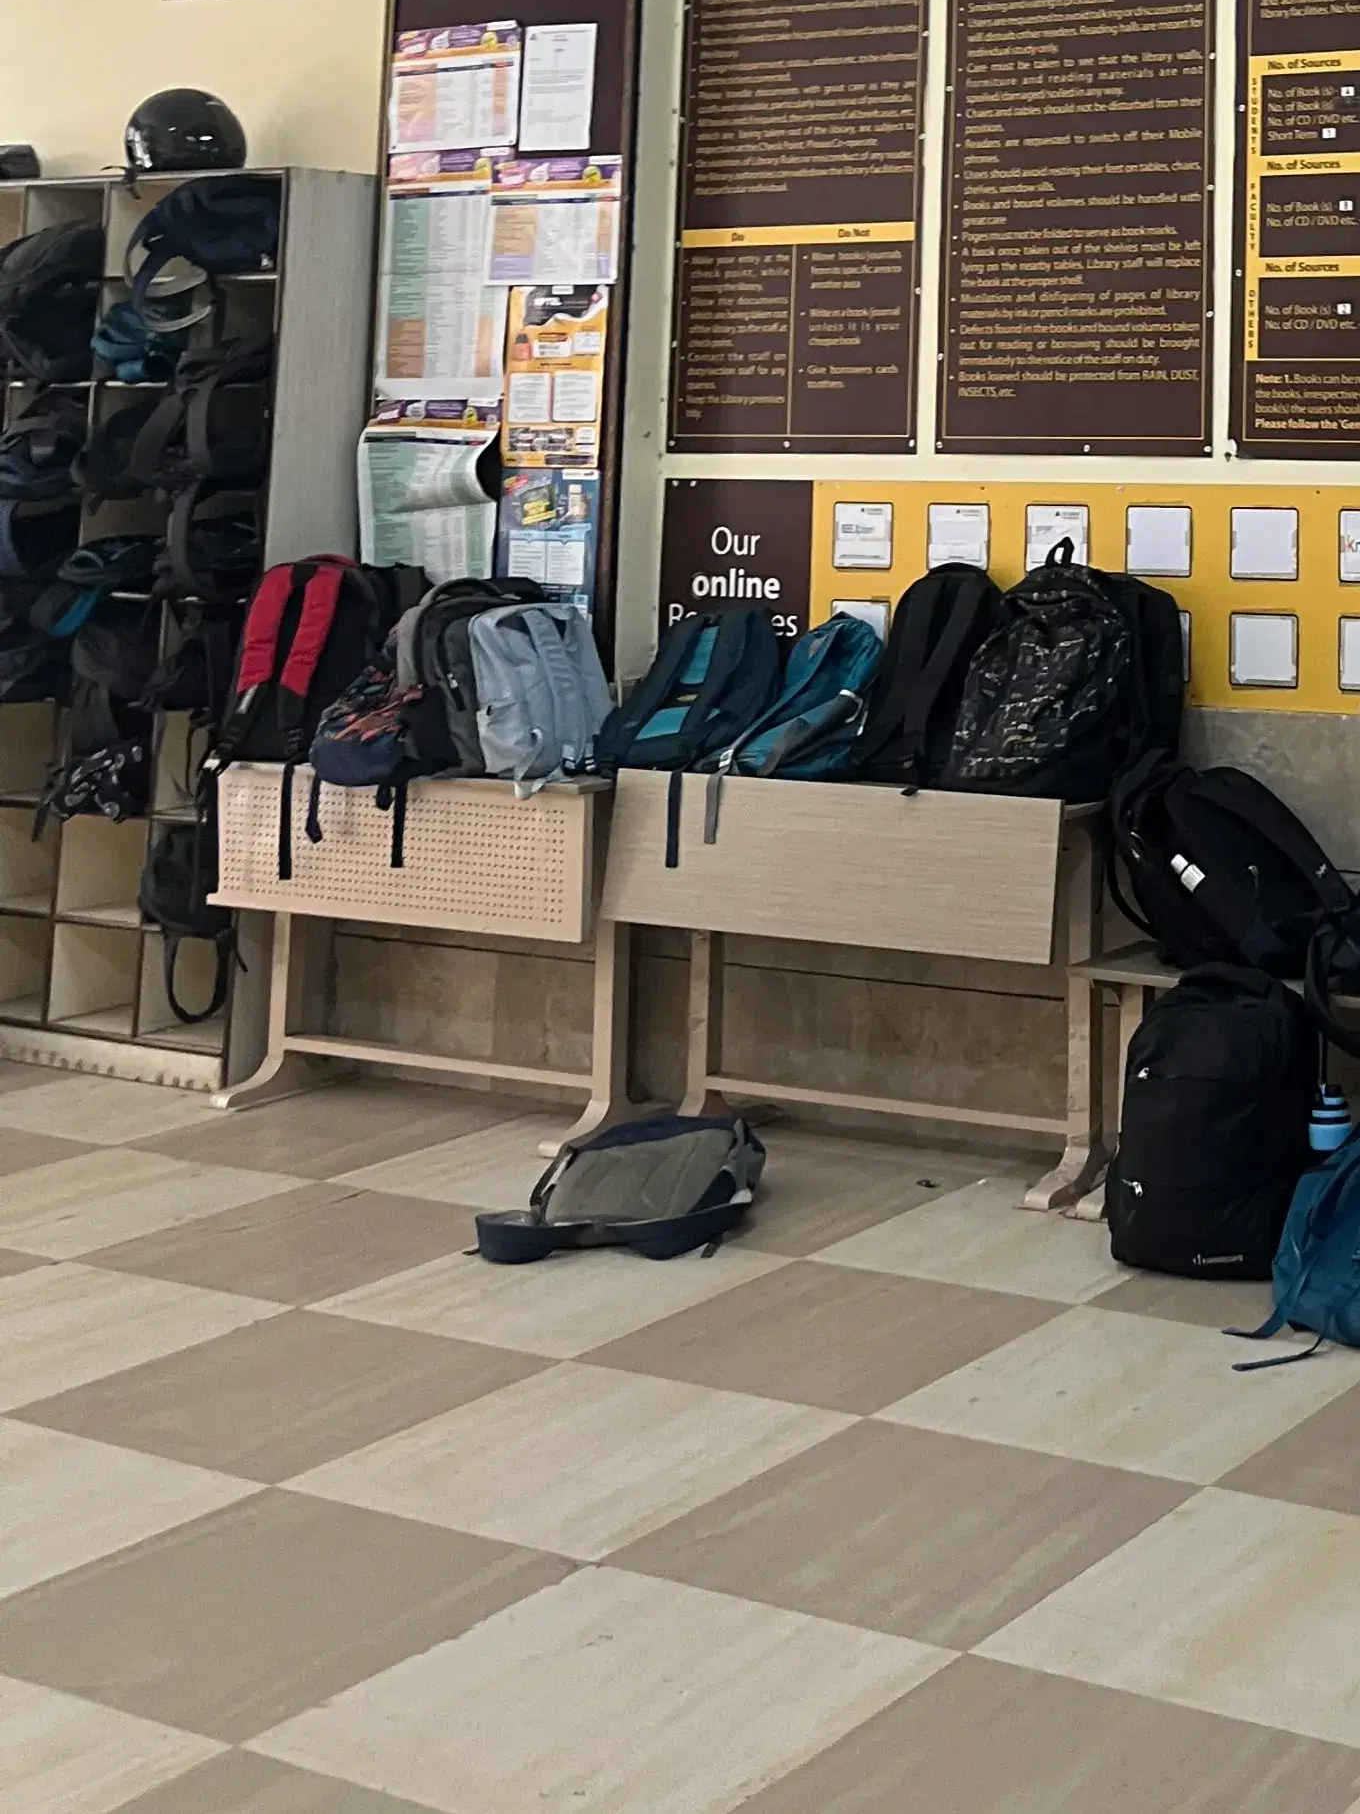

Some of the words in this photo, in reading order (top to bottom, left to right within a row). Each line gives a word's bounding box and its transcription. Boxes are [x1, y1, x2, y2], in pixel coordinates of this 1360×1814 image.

[1286, 159, 1298, 170] of
[1300, 159, 1340, 170] Sources
[711, 525, 761, 558] Our
[692, 569, 781, 600] online
